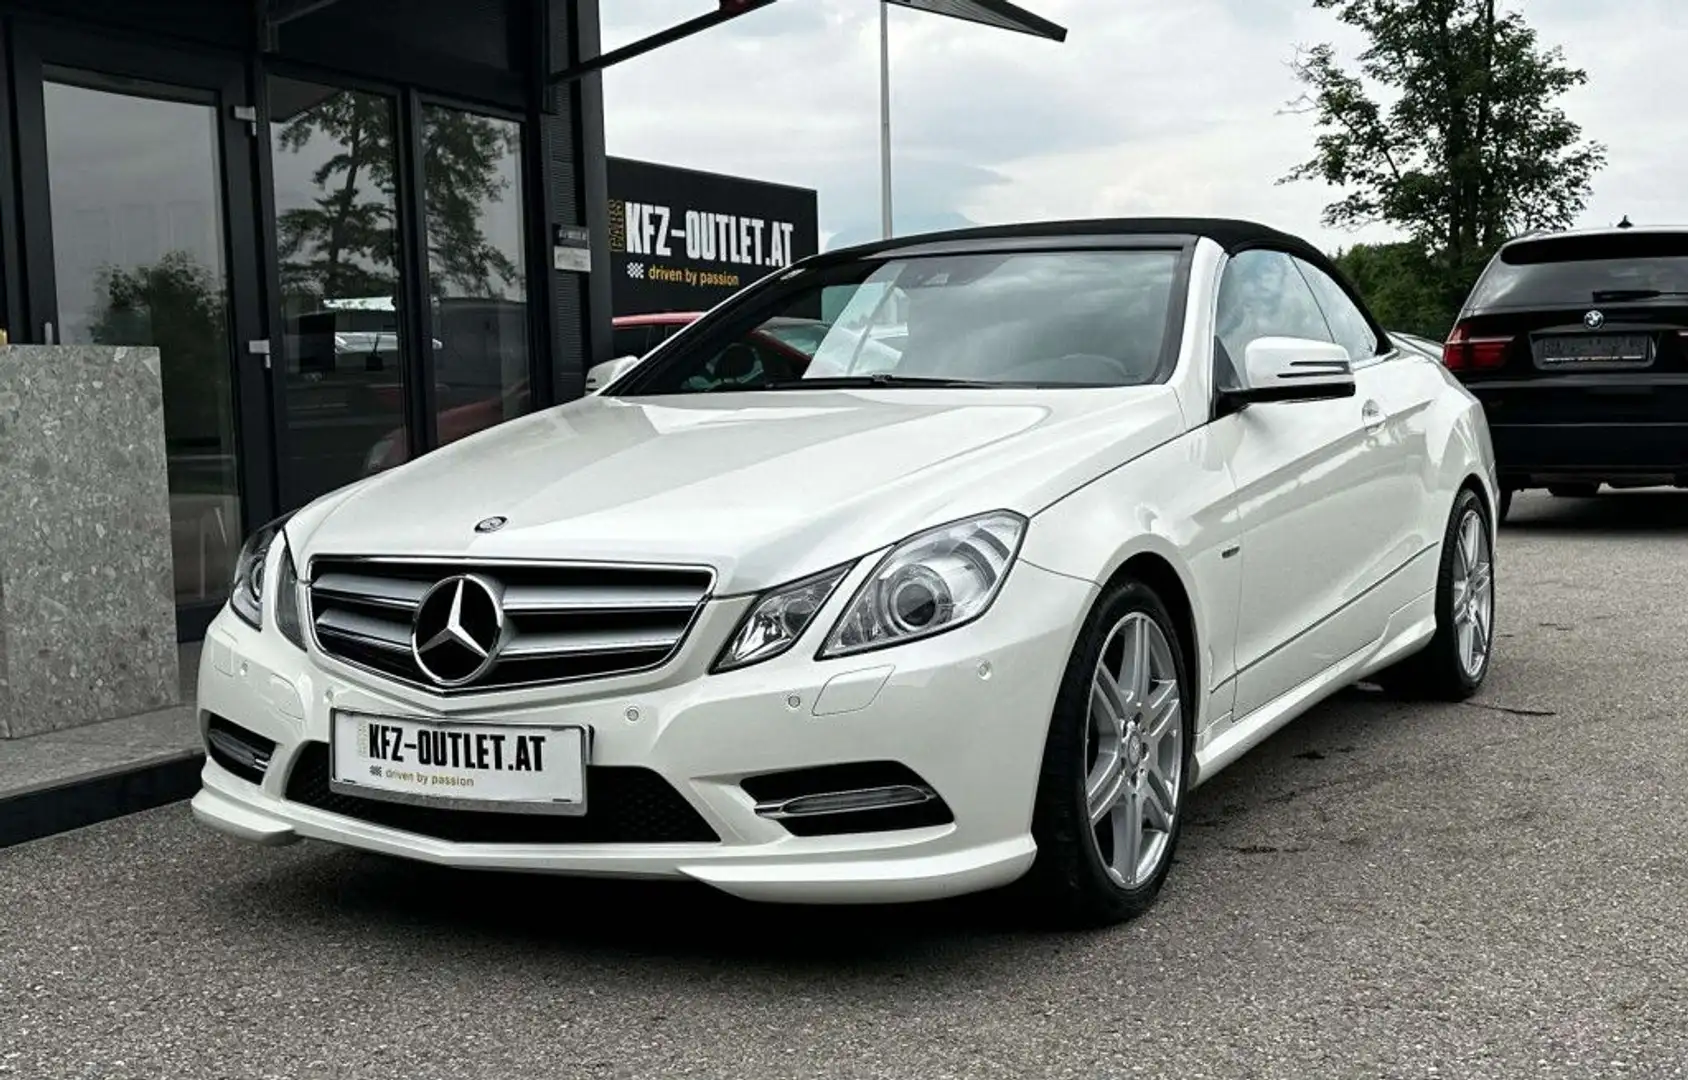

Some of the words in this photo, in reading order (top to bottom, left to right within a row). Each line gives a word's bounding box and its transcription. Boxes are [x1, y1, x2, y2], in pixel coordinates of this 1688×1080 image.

[625, 201, 794, 267] KFZ-OUTLET.AT
[648, 264, 682, 281] driven
[684, 268, 697, 286] by
[700, 271, 740, 287] passion
[369, 723, 546, 772] KFZ-OUTLET.AT
[385, 769, 414, 782] driven
[416, 772, 429, 786] by
[431, 775, 475, 787] passion
